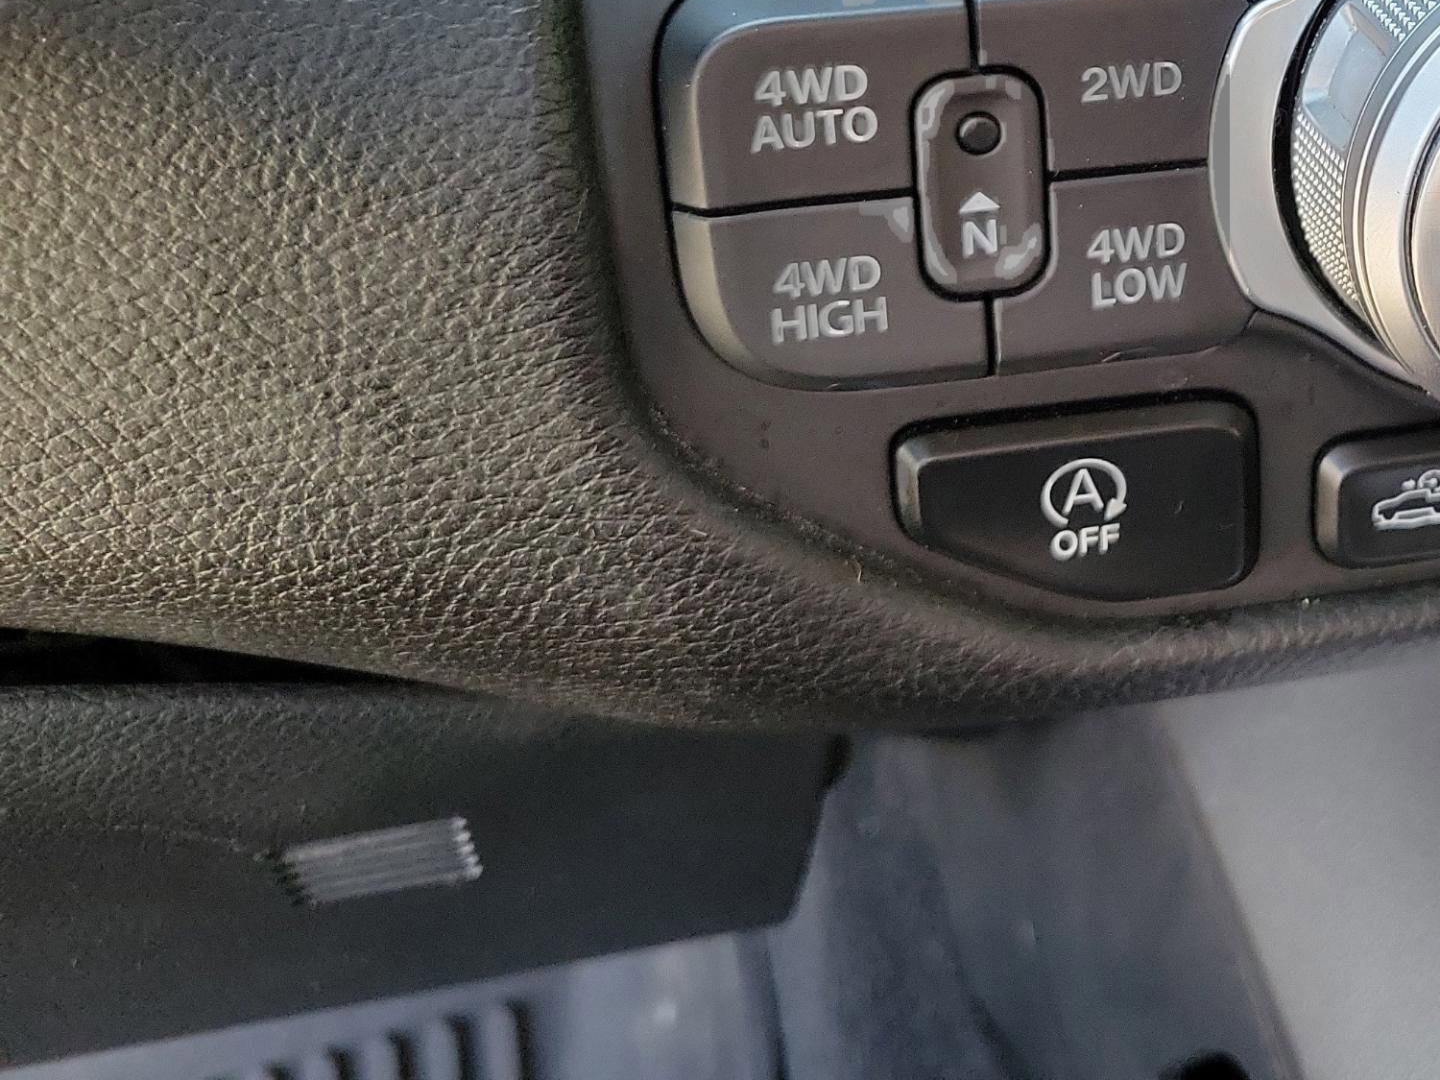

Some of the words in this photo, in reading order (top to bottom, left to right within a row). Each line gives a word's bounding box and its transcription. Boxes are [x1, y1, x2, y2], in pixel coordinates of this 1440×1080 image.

[754, 64, 869, 107] 4WD
[1080, 61, 1183, 103] 2WD
[750, 105, 878, 153] AUTO
[962, 219, 999, 258] N
[1086, 222, 1186, 265] 4WD
[772, 255, 882, 299] 4WD
[1090, 262, 1188, 310] LOW
[769, 295, 889, 345] HIGH
[1049, 522, 1121, 561] OFF
